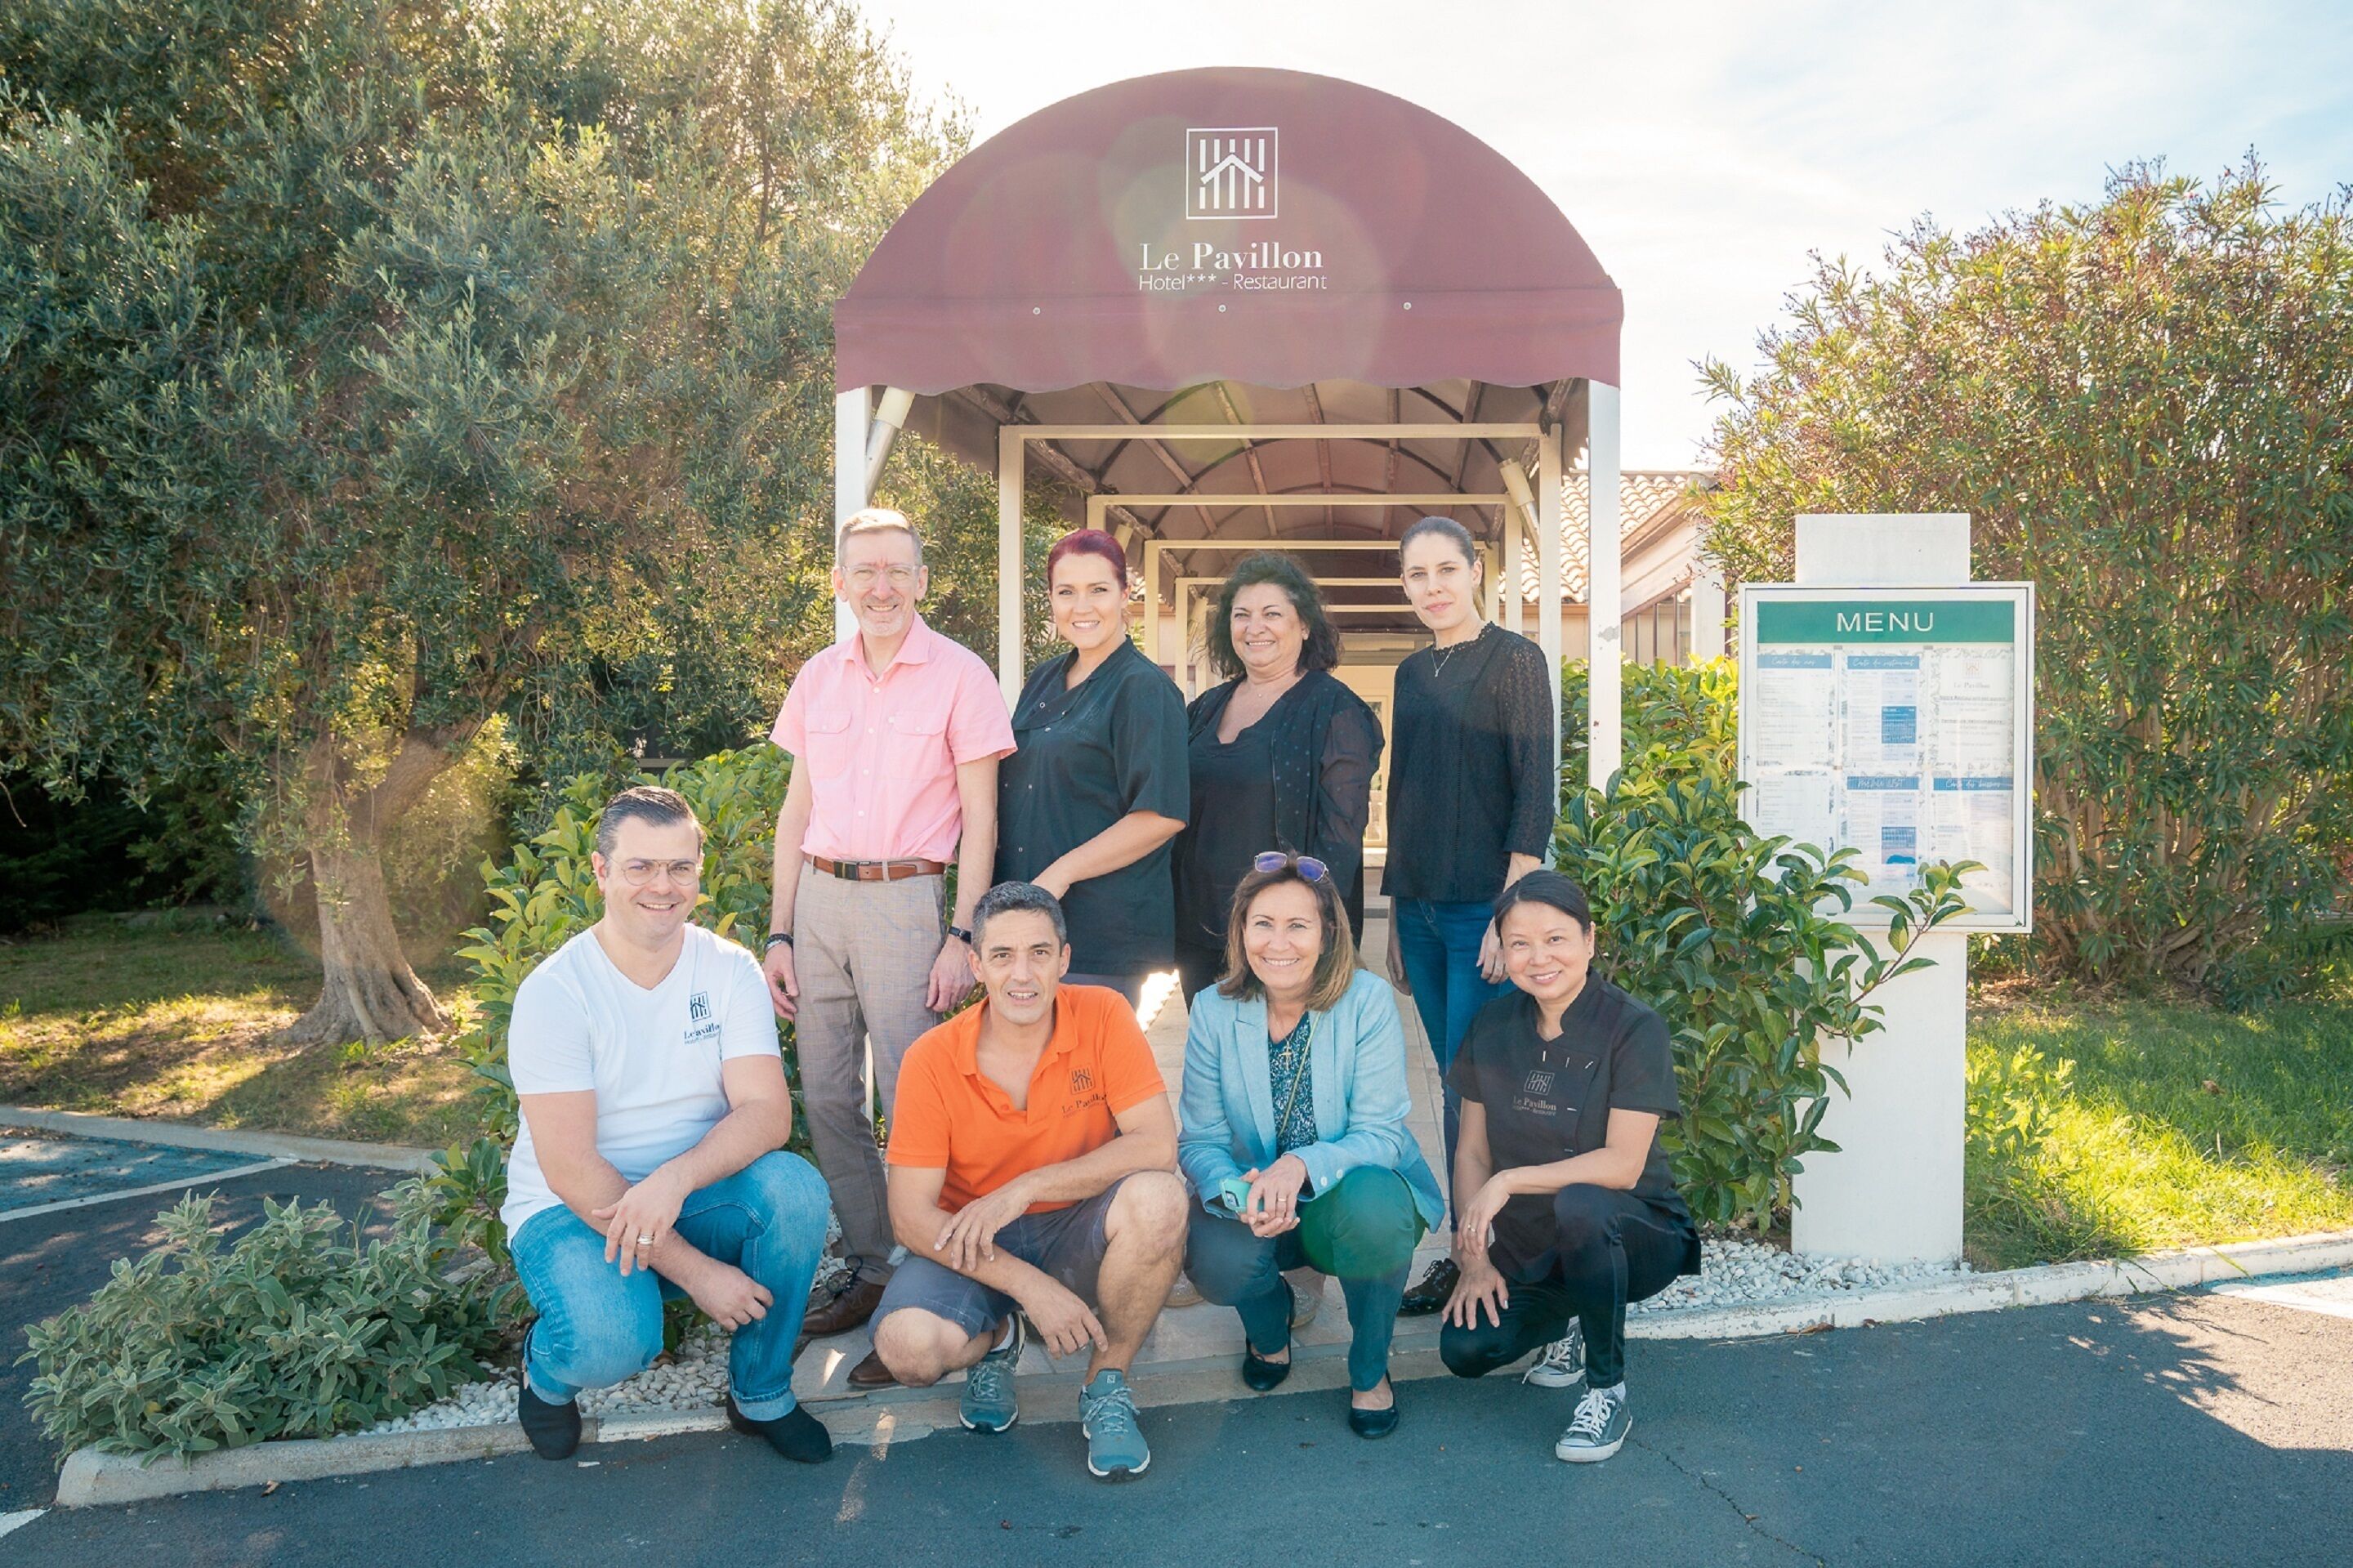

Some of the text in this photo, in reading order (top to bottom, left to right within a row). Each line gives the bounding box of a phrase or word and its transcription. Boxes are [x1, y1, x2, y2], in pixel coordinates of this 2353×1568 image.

[1139, 242, 1324, 270] Le Pavillon
[1234, 274, 1328, 290] Restaurant
[1837, 612, 1934, 632] MENU
[1524, 1097, 1556, 1111] Pavillon
